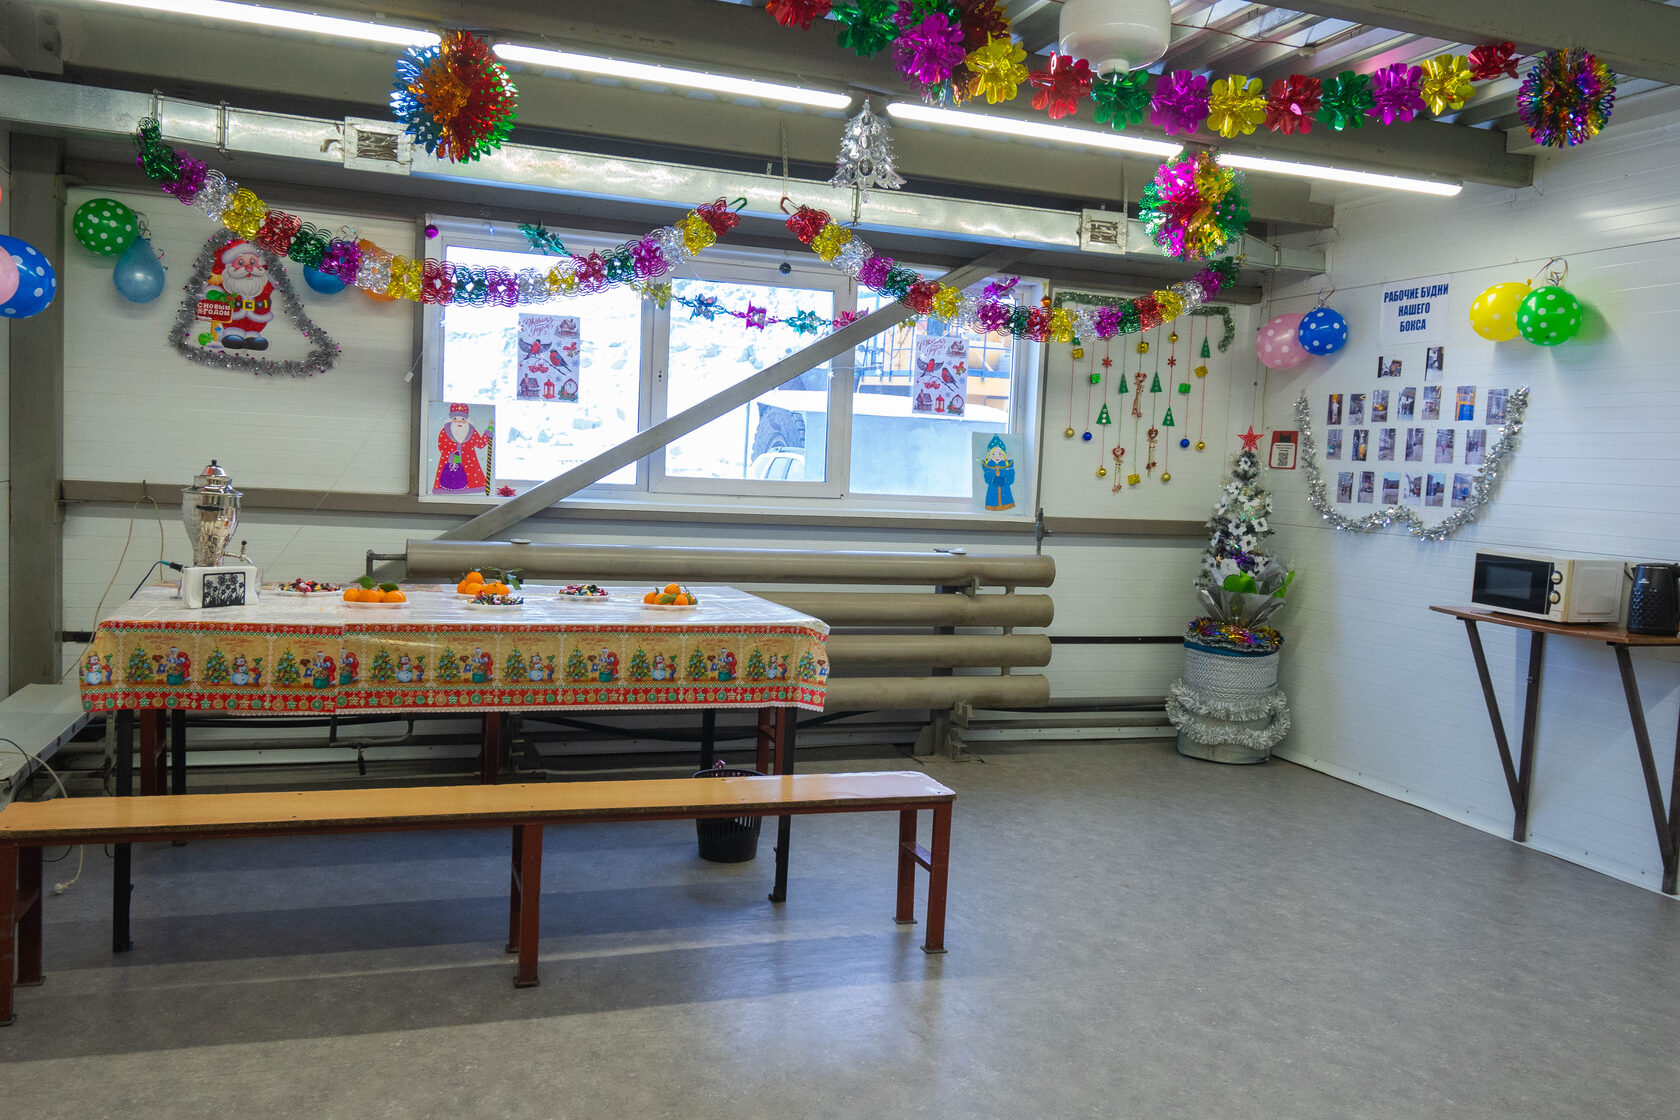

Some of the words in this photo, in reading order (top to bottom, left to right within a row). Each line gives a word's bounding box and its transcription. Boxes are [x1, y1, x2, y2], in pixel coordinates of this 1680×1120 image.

[1383, 288, 1419, 303] РАБОЧИЕ
[1420, 283, 1449, 299] БУДНИ
[1398, 302, 1431, 317] НАШЕГО
[1399, 319, 1427, 333] БОКСА
